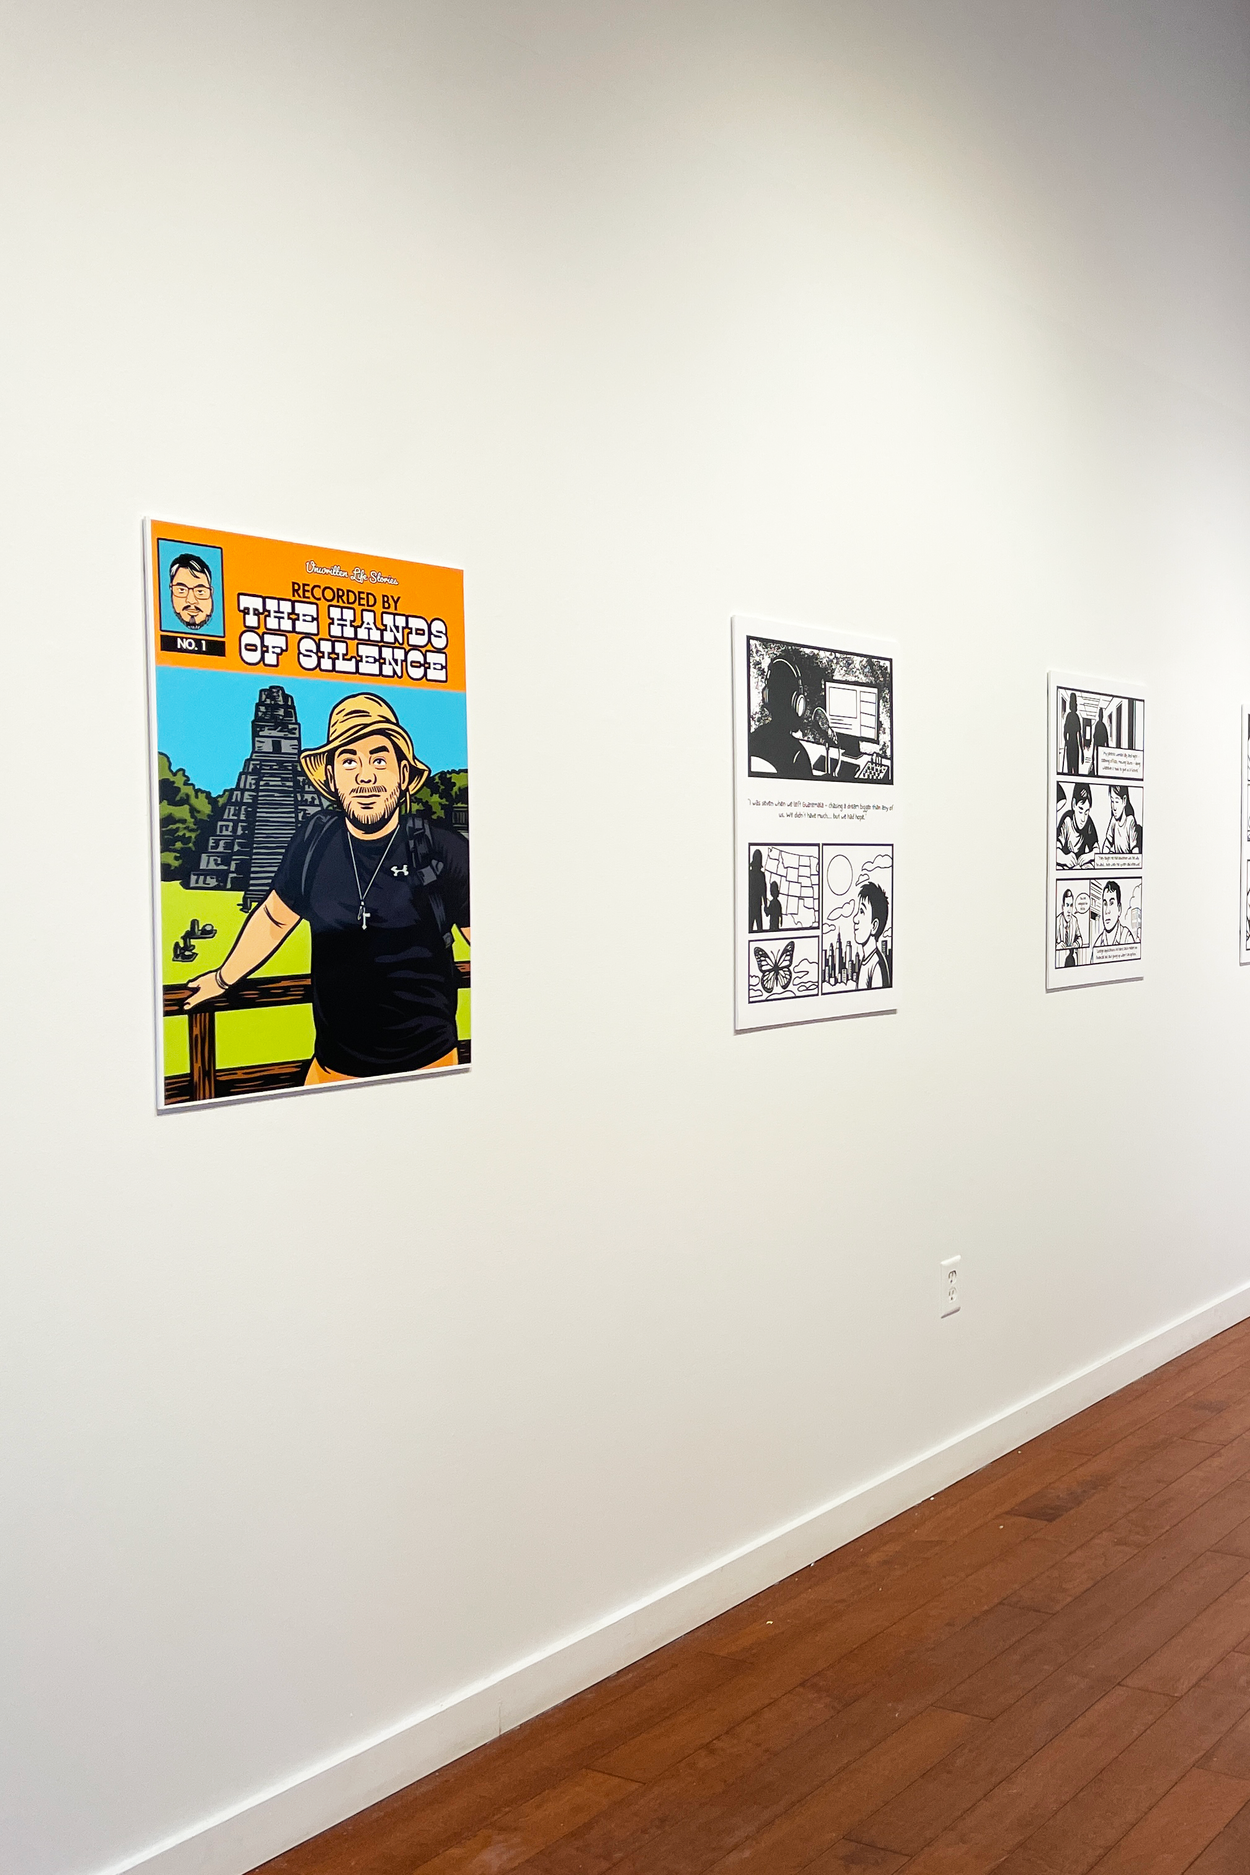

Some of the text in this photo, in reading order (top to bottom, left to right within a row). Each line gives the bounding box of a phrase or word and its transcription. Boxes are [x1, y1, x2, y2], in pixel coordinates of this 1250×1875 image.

[305, 560, 399, 585] Unwritten Life Stories
[292, 582, 400, 611] RECORDED BY
[238, 593, 448, 650] THE HANDS
[177, 638, 206, 651] NO. 1
[239, 630, 448, 682] OF SILENCE
